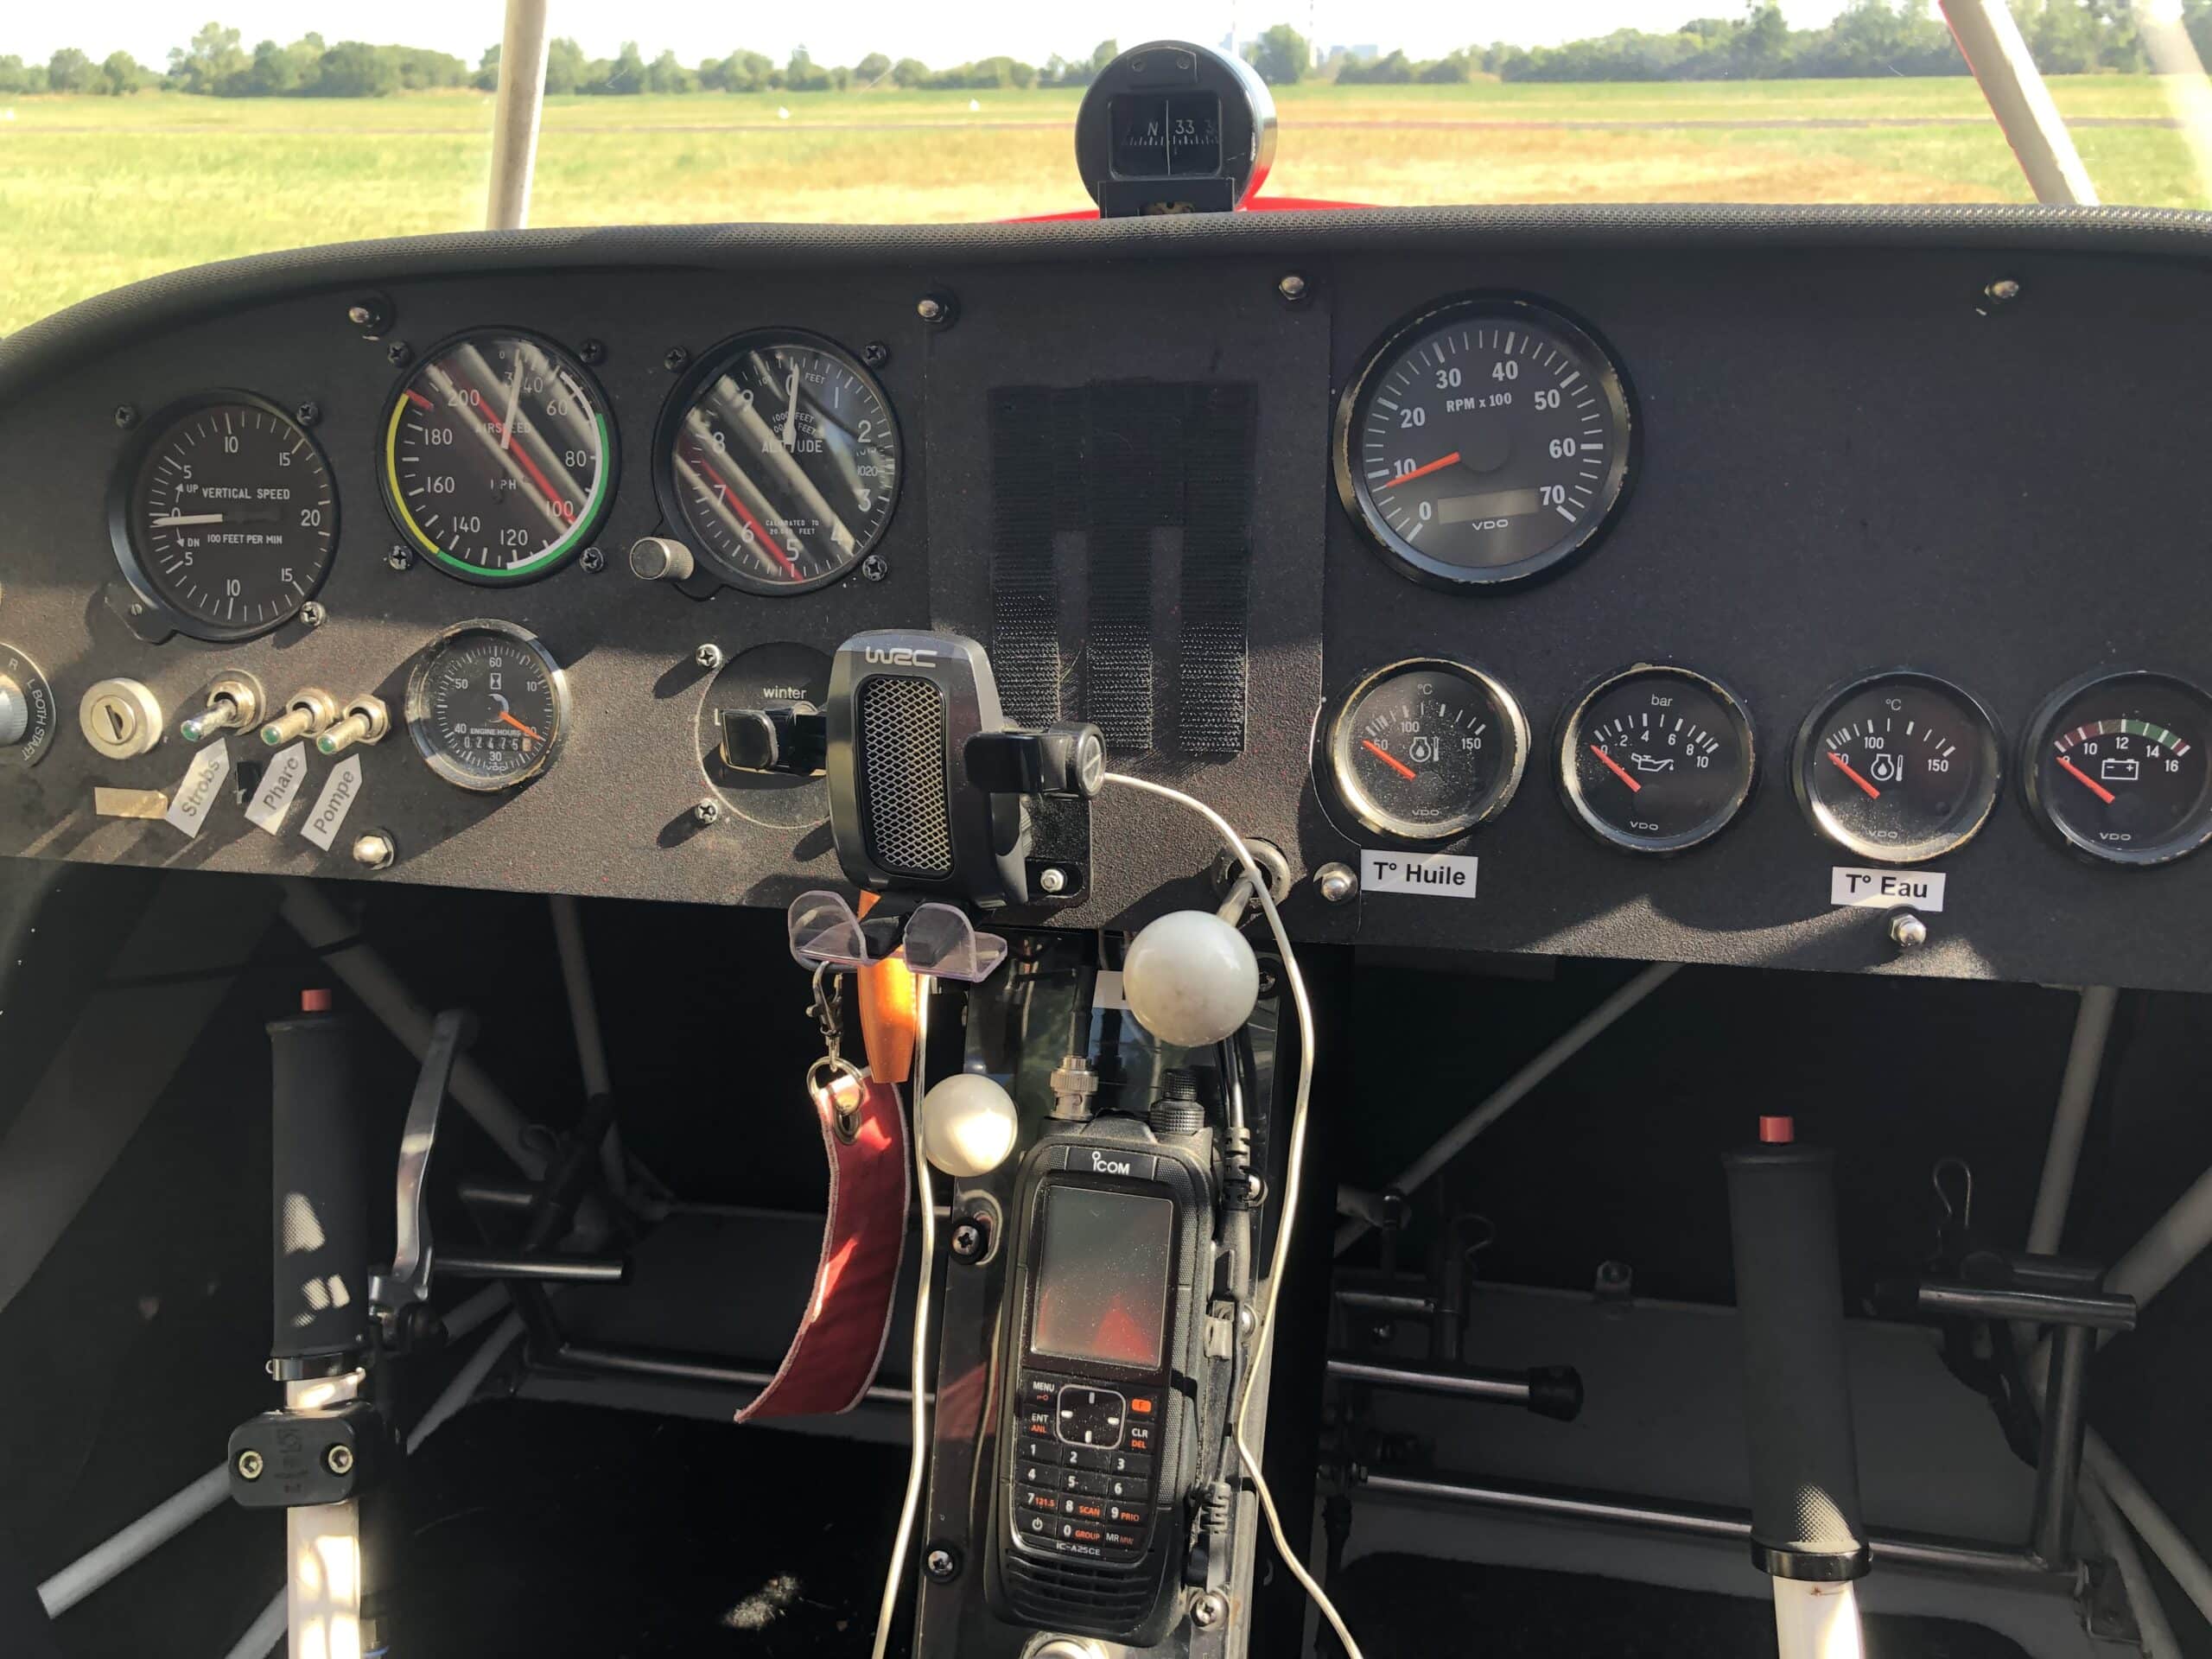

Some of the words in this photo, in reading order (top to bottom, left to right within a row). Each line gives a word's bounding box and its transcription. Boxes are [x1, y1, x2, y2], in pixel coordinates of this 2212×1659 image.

[1147, 121, 1159, 137] N
[1175, 119, 1195, 135] 33
[1492, 360, 1518, 381] 40
[524, 377, 543, 393] 40
[804, 372, 826, 385] FEET
[1436, 368, 1462, 389] 30
[448, 390, 480, 406] 200
[1446, 397, 1475, 413] RPM
[1479, 399, 1486, 408] x
[1489, 392, 1512, 407] 100
[1534, 389, 1560, 410] 50
[546, 400, 569, 416] 60
[795, 411, 815, 423] FEET
[1400, 407, 1426, 429] 20
[798, 422, 817, 435] FEET
[857, 420, 872, 442] 2
[225, 435, 238, 454] 10
[424, 429, 453, 446] 180
[712, 431, 726, 454] 8
[1548, 437, 1576, 458] 60
[279, 453, 290, 467] 15
[565, 450, 587, 467] 80
[183, 466, 192, 479] 5
[857, 465, 878, 477] 1020
[1393, 458, 1417, 479] 10
[187, 484, 199, 494] UP
[427, 477, 455, 493] 160
[202, 487, 252, 499] VERTICAL
[257, 489, 290, 500] SPEED
[714, 484, 727, 507] 7
[858, 488, 872, 512] 3
[1540, 485, 1565, 505] 70
[545, 500, 574, 517] 100
[1419, 501, 1431, 520] 0
[301, 510, 321, 527] 20
[453, 517, 480, 533] 140
[1472, 518, 1509, 531] VDO
[499, 529, 529, 546] 120
[741, 520, 754, 543] 6
[187, 537, 200, 548] DN
[207, 534, 223, 543] 100
[223, 534, 245, 544] FEET
[246, 535, 263, 544] PER
[266, 536, 283, 544] MIN
[786, 538, 799, 562] 5
[185, 552, 194, 566] 5
[281, 569, 293, 582] 15
[226, 579, 240, 596] 10
[489, 657, 501, 668] 60
[865, 646, 938, 668] WRC
[9, 658, 19, 671] R
[26, 678, 35, 690] L
[454, 679, 468, 690] 50
[527, 681, 537, 691] 10
[762, 684, 807, 700] winter
[1650, 693, 1673, 707] bar
[33, 690, 47, 726] BOTH
[454, 722, 467, 734] 40
[1400, 721, 1421, 733] 100
[1619, 734, 1628, 747] 2
[1640, 729, 1649, 742] 4
[1668, 733, 1676, 746] 6
[21, 726, 45, 760] START
[1462, 738, 1481, 750] 150
[1687, 743, 1694, 755] 8
[1864, 736, 1884, 750] 100
[2084, 743, 2098, 755] 10
[2115, 736, 2129, 750] 12
[489, 752, 501, 761] 30
[2146, 745, 2160, 759] 14
[1697, 755, 1709, 769] 10
[1927, 759, 1949, 772] 150
[2165, 760, 2179, 772] 16
[181, 760, 220, 817] Strobs
[263, 756, 299, 810] Phare
[313, 770, 354, 835] Pompe
[1630, 821, 1659, 831] VDO
[1869, 830, 1898, 839] VDO
[2100, 832, 2132, 842] VDO
[1405, 864, 1466, 886] Huile
[1880, 876, 1928, 899] Eau
[1033, 1381, 1054, 1392] MENU
[1032, 1414, 1049, 1422] ENT
[1031, 1424, 1047, 1433] ANL
[1132, 1427, 1148, 1438] CLR
[1030, 1445, 1036, 1455] 1
[1131, 1440, 1147, 1449] DEL
[1070, 1452, 1077, 1464] 2
[1116, 1459, 1125, 1470] 3
[1028, 1469, 1036, 1480] 4
[1068, 1476, 1075, 1488] 5
[1115, 1483, 1122, 1495] 6
[1028, 1493, 1035, 1503] 7
[1035, 1497, 1055, 1507] 121.5
[1065, 1500, 1073, 1512] 8
[1078, 1505, 1101, 1516] SCAN
[1111, 1507, 1119, 1519] 9
[1120, 1512, 1140, 1521] PRIO
[1063, 1524, 1071, 1536] 0
[1075, 1529, 1101, 1540] GROUP
[1106, 1533, 1120, 1542] MR
